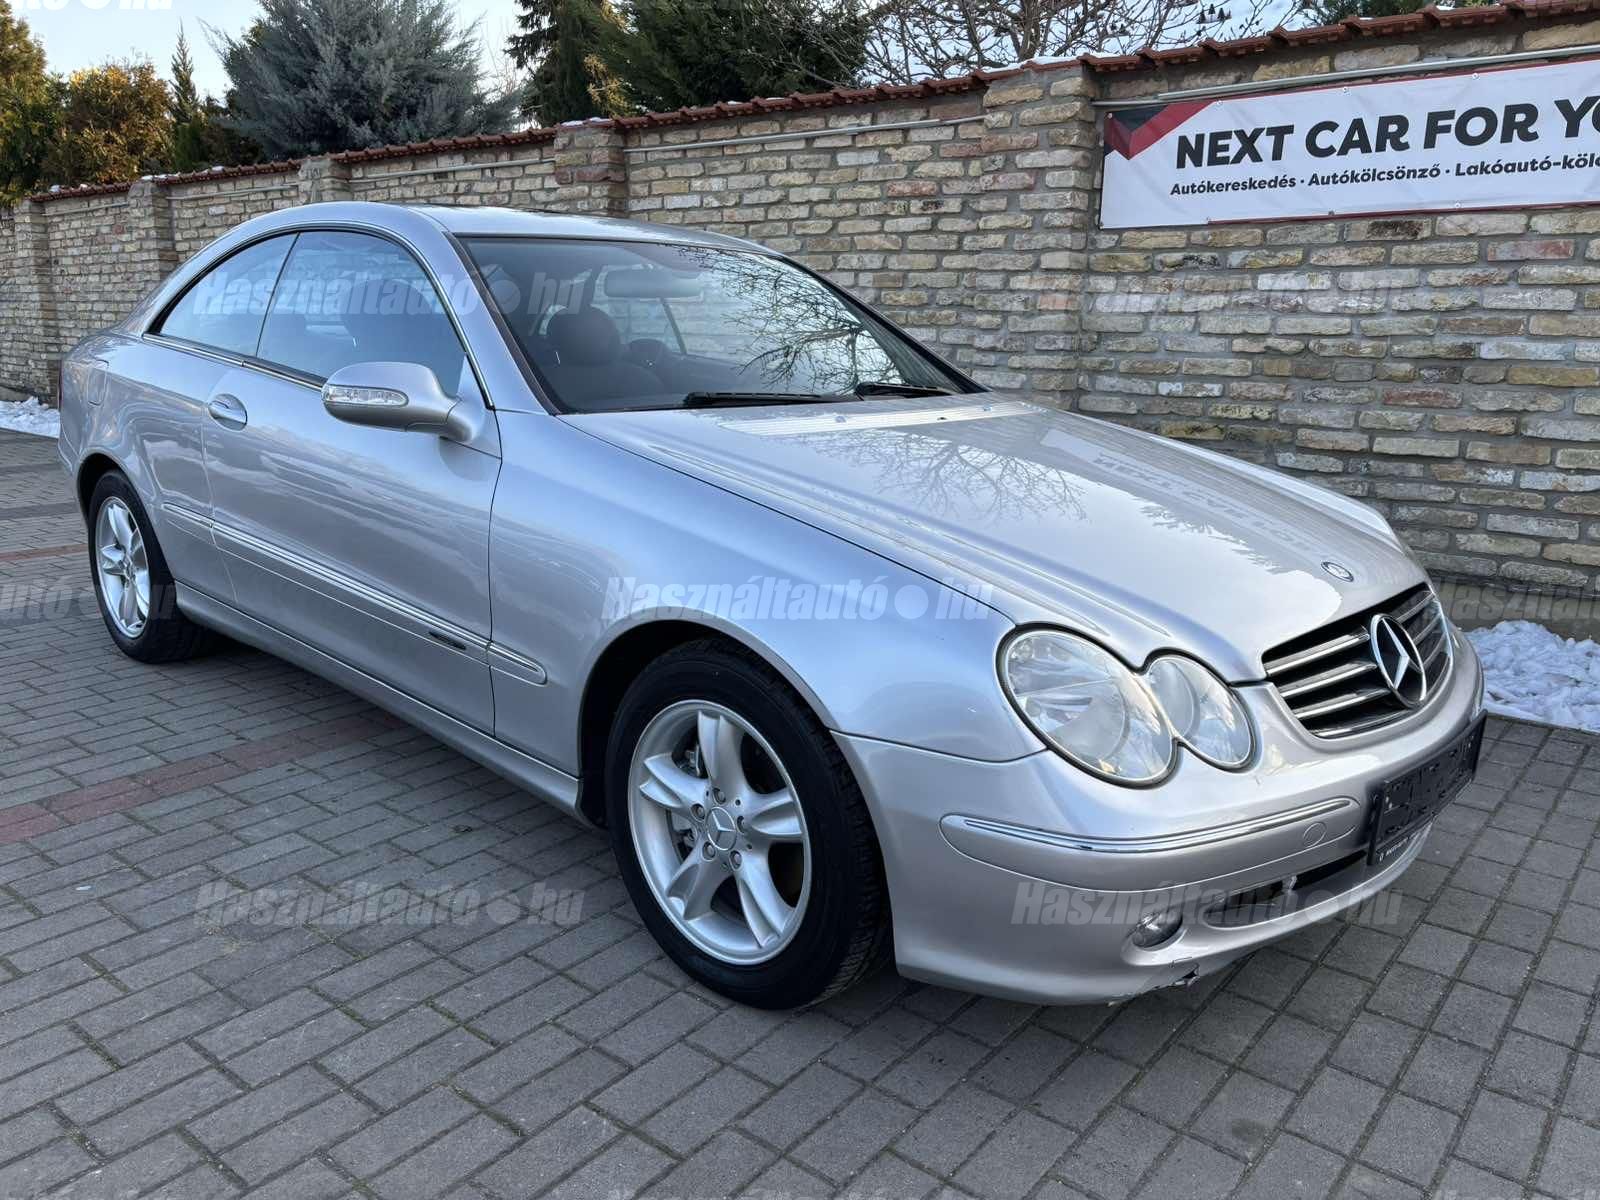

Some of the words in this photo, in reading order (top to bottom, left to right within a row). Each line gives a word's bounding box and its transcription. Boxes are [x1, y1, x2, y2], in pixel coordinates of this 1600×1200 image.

[1176, 124, 1294, 169] NEXT
[1305, 114, 1410, 158] CAR
[1423, 103, 1539, 149] FOR
[1554, 95, 1600, 138] Y
[1170, 174, 1296, 195] Autókereskedés
[1308, 163, 1440, 186] Autókölcsönző
